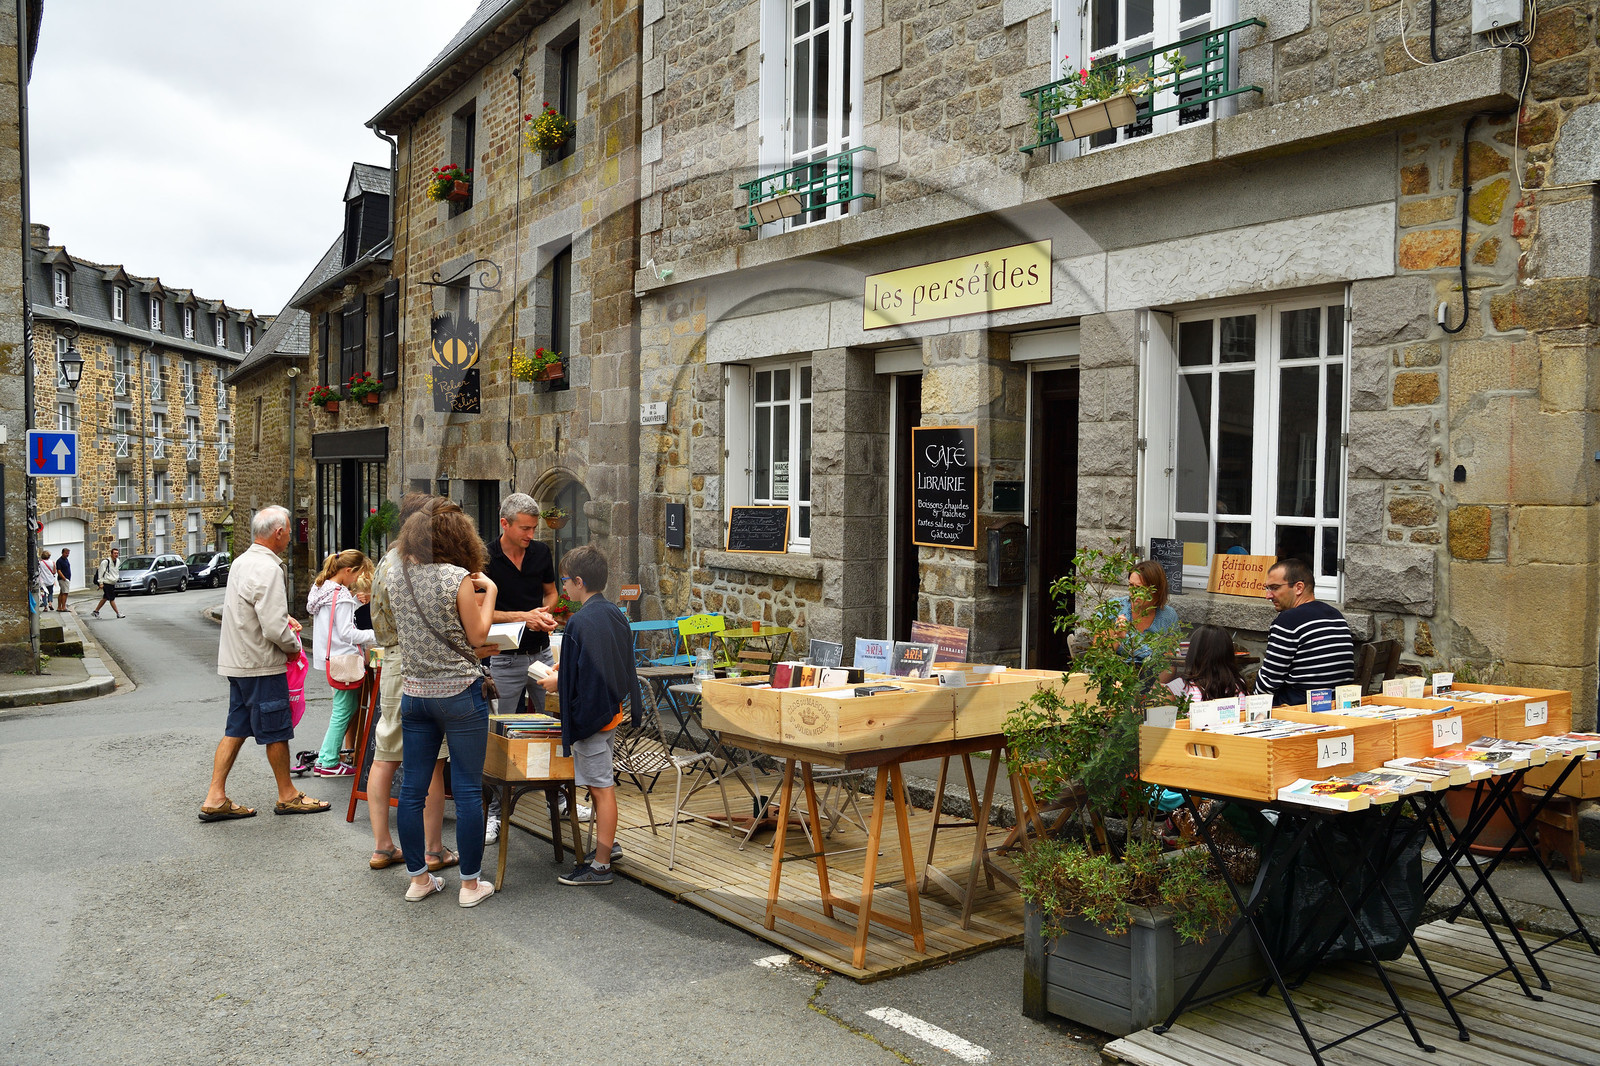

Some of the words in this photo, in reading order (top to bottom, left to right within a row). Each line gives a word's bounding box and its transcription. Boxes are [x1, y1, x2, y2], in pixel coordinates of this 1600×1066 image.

[872, 284, 903, 312] les
[911, 258, 1040, 317] perséides
[438, 379, 470, 393] Relier
[918, 499, 944, 509] Boissons
[944, 498, 970, 511] chaudes
[930, 529, 960, 542] Gâteaux
[1222, 556, 1264, 573] Éditions
[1220, 570, 1235, 581] les
[865, 645, 883, 656] ARIA
[903, 649, 923, 660] ARIA
